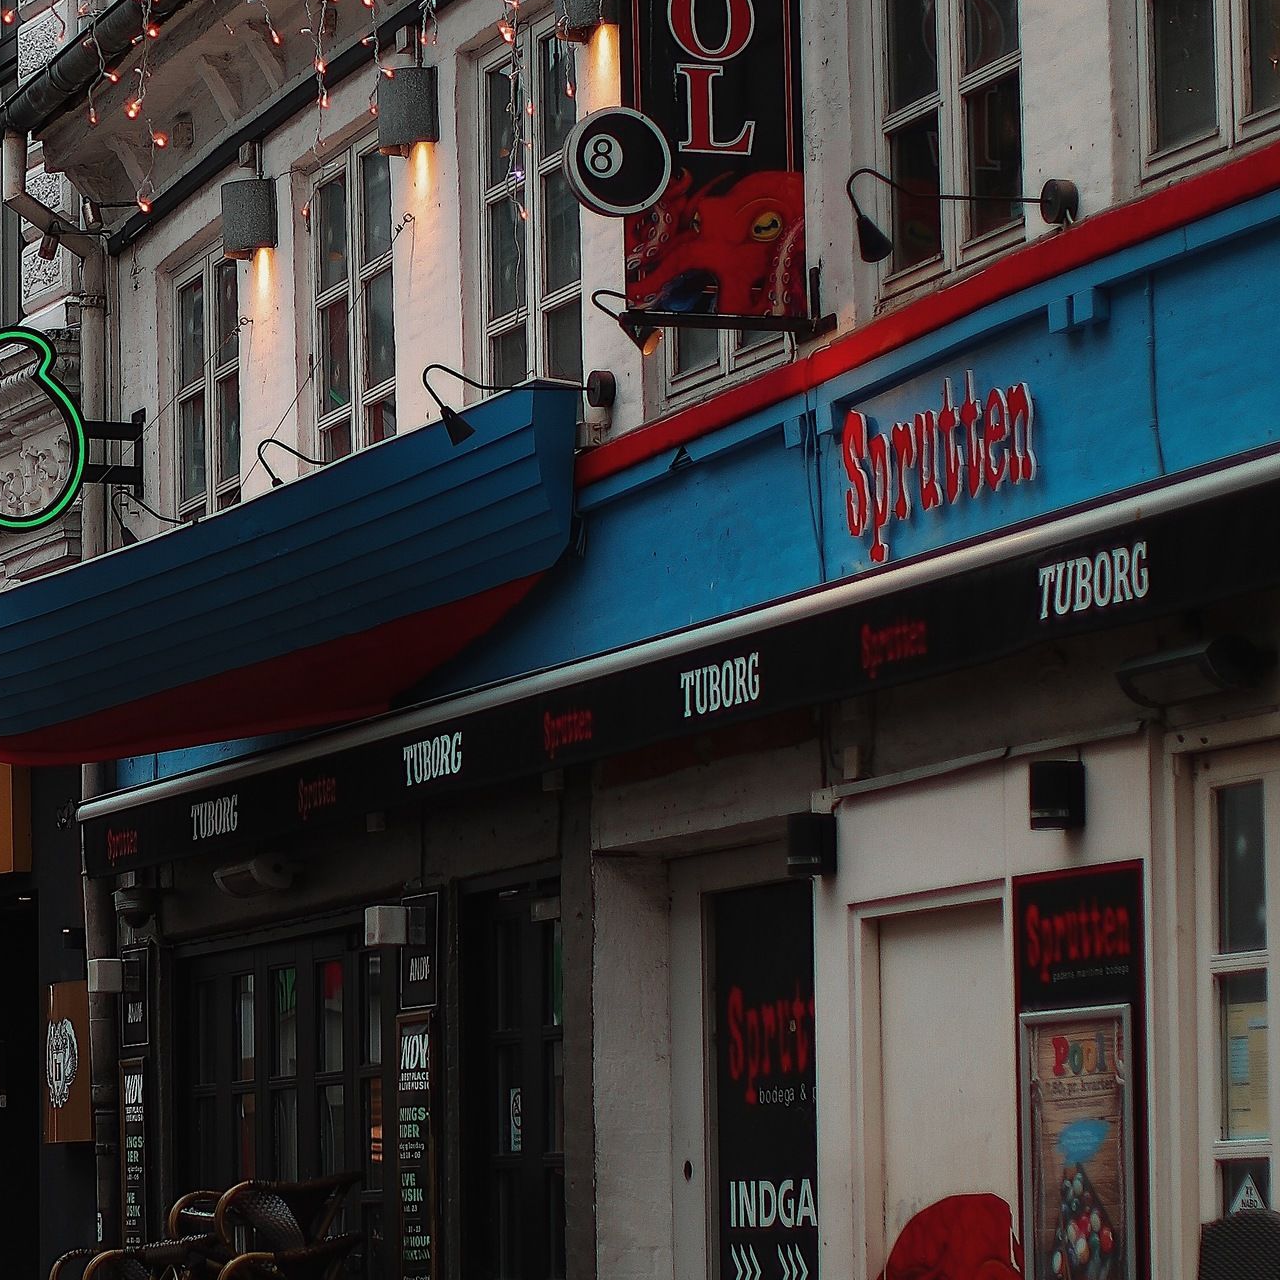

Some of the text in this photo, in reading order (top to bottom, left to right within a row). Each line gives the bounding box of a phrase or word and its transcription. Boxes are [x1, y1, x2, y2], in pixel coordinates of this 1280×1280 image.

[841, 368, 1037, 563] Sprutten
[1037, 540, 1150, 621] TUBORG
[679, 651, 761, 719] TUBORG
[403, 731, 463, 787] TUBORG
[191, 793, 239, 841] TUBORG
[1052, 1032, 1108, 1076] Pool
[760, 1084, 795, 1107] bodega
[730, 1178, 818, 1228] INDGA
